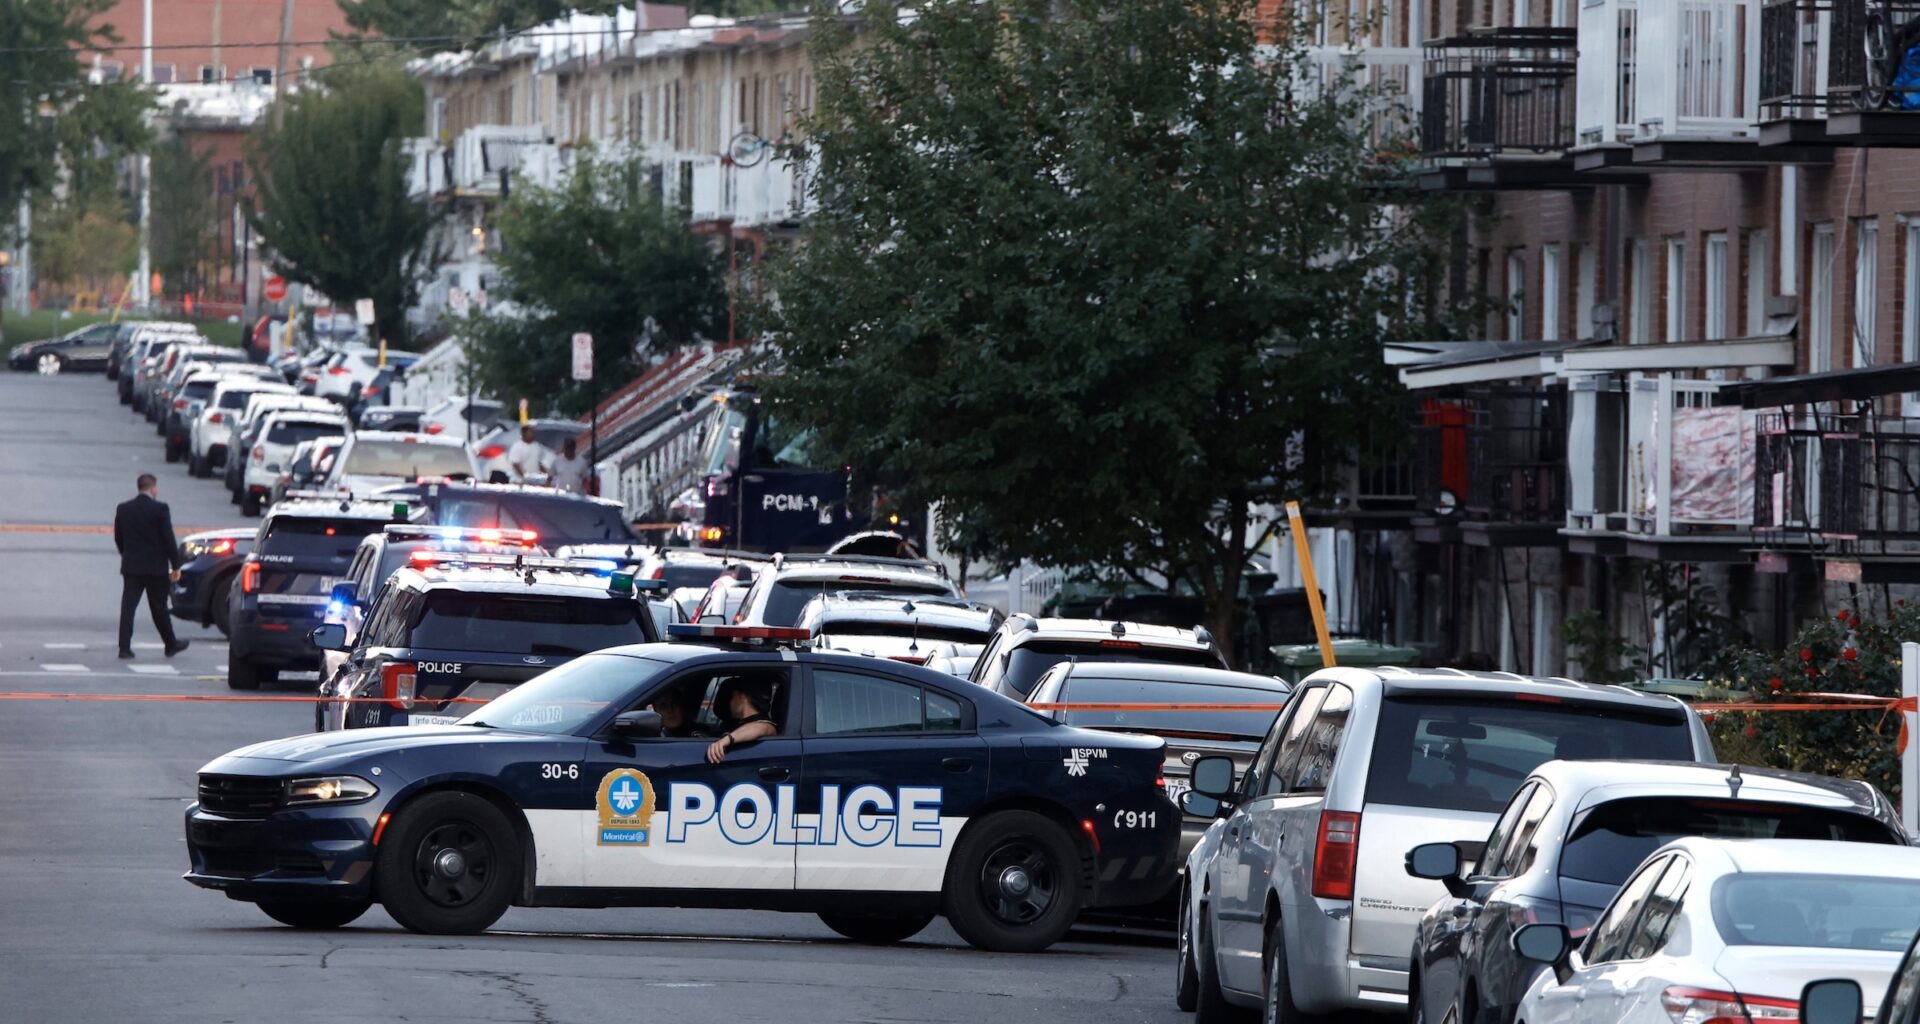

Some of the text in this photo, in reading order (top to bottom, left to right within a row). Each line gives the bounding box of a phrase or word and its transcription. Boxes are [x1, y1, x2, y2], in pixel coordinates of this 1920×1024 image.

[263, 555, 294, 563] POLICE
[417, 662, 462, 674] POLICE
[1079, 748, 1108, 759] SPVM
[541, 763, 579, 779] 30-6
[666, 781, 944, 847] POLICE
[1125, 811, 1156, 828] 911
[603, 831, 635, 841] Montréal
